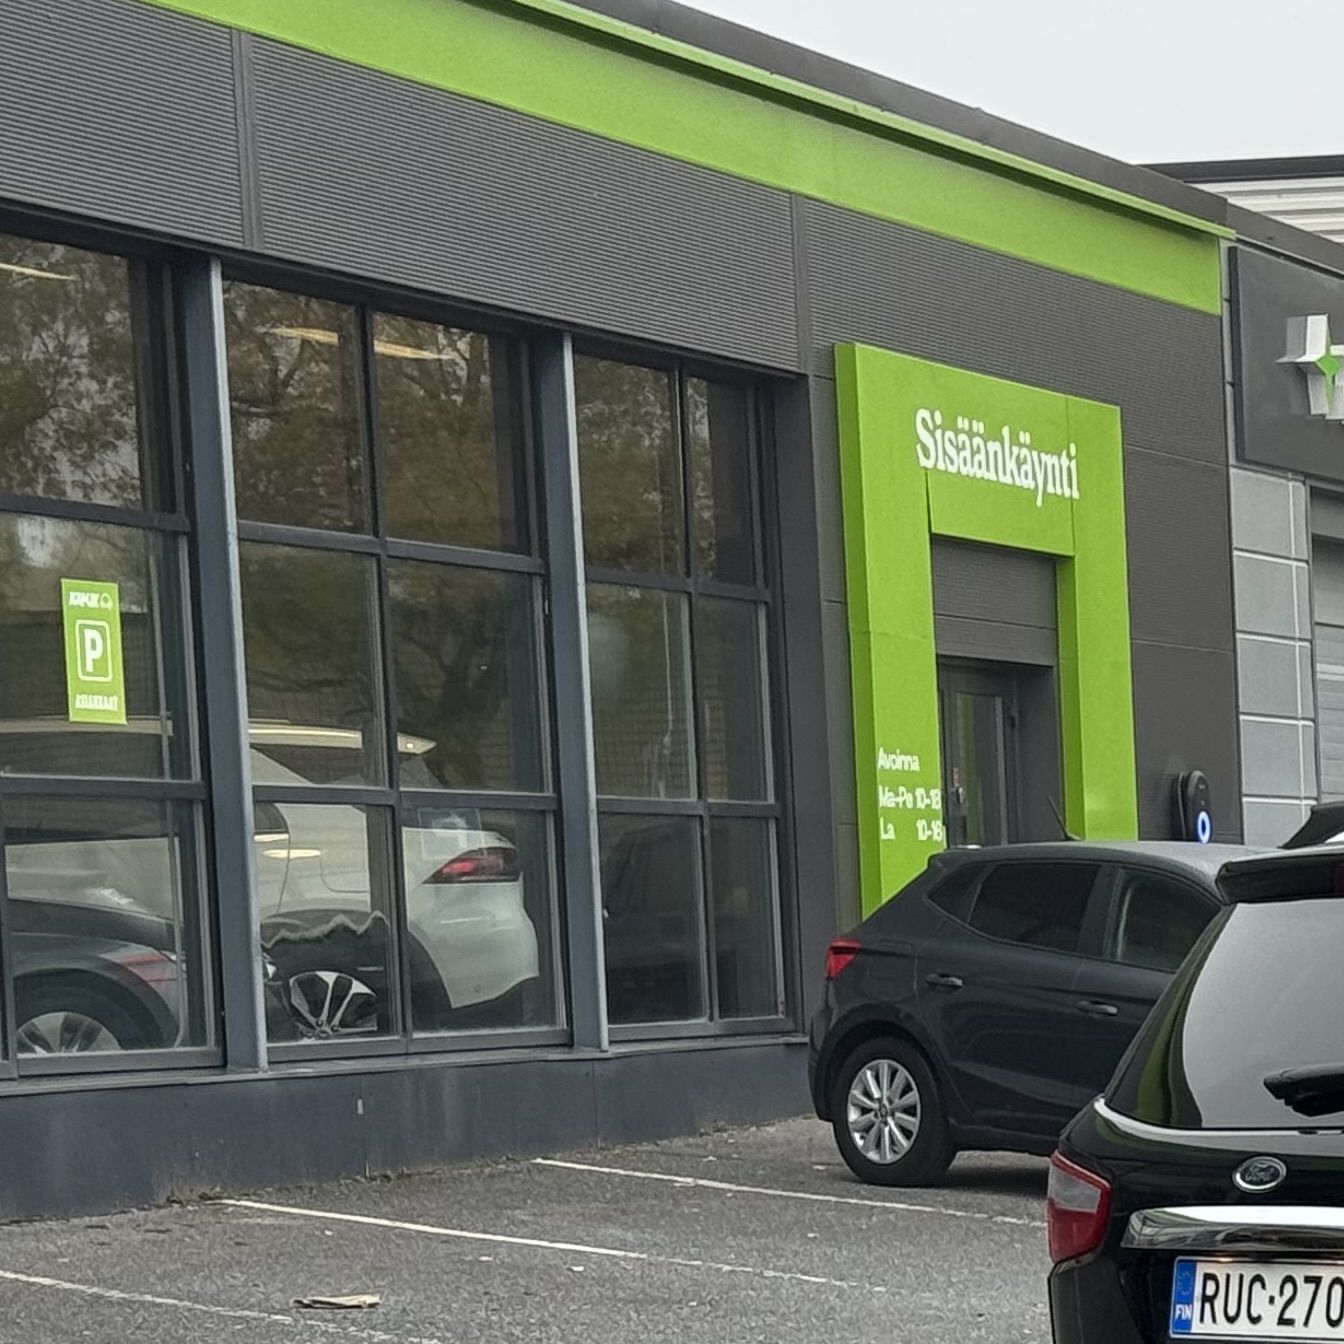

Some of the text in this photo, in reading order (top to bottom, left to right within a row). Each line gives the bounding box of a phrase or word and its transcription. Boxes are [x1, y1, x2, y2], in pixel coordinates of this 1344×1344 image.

[915, 408, 1080, 507] Sisäänkäynti
[84, 628, 104, 673] P
[877, 747, 920, 772] Avoinna
[880, 816, 896, 840] La
[1175, 1303, 1193, 1320] FIN
